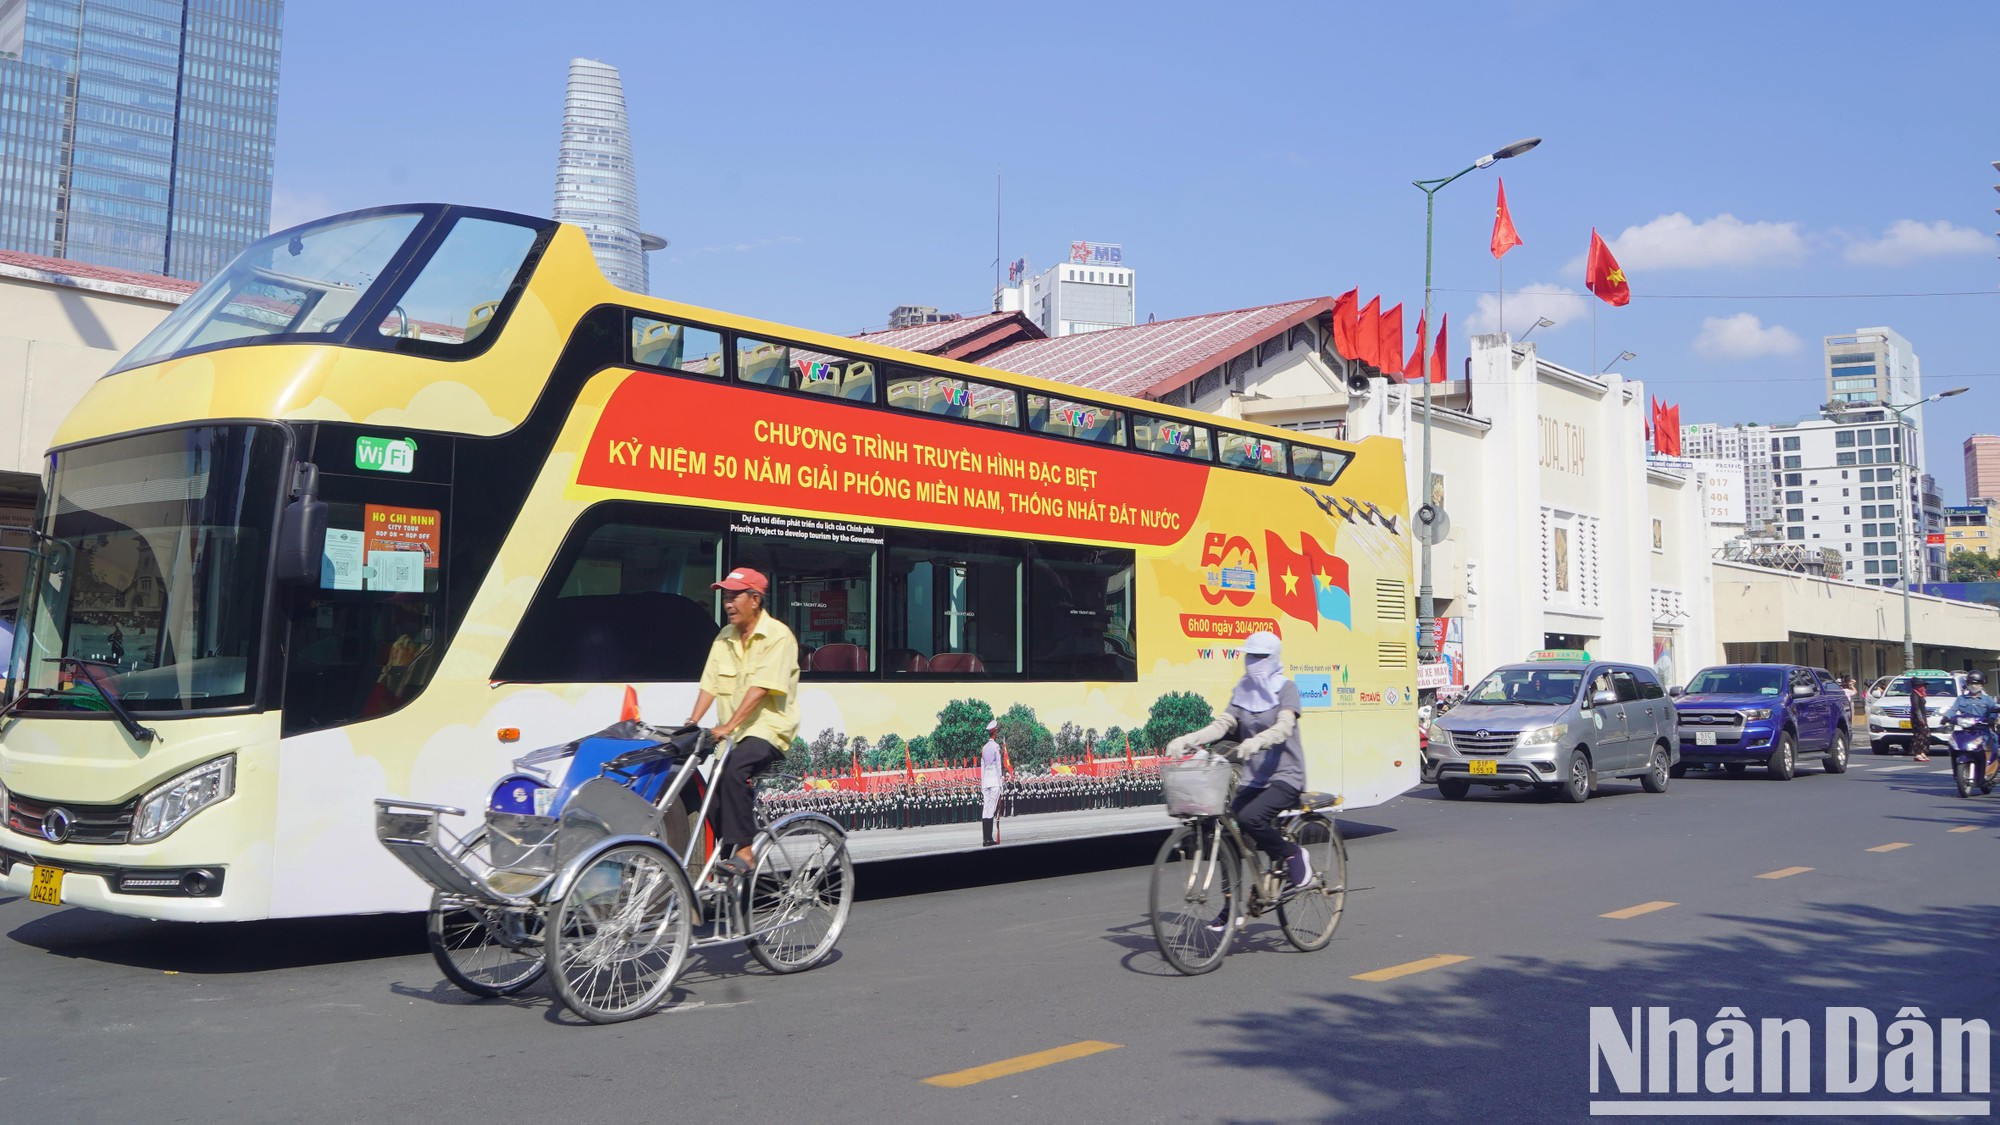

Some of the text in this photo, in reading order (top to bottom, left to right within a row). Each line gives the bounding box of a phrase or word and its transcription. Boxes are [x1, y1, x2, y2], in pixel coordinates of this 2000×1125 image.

[1094, 246, 1122, 262] MB
[797, 359, 830, 381] VTV
[1063, 409, 1094, 429] VTV9
[754, 420, 1097, 491] CHƯƠNG TRÌNH TRUYỀN HÌNH ĐẶC BIỆT
[609, 437, 1180, 530] KỶ NIỆM 50 NĂM GIẢI PHÓNG MIỀN NAM, THỐNG NHẤT ĐẤT NƯỚC
[372, 512, 435, 526] HO CHI MINH
[1711, 508, 1728, 516] 751
[404, 524, 419, 532] TOUR
[742, 514, 752, 524] Dự
[770, 516, 786, 525] điểm
[786, 518, 800, 528] phát
[816, 520, 824, 529] du
[825, 522, 834, 532] lịch
[846, 523, 862, 533] Chính
[730, 524, 884, 545] Priority Project to develop tourism by the Government
[1188, 618, 1274, 636] 6h00 ngày 30/4/2025
[1197, 649, 1214, 660] VTV1
[40, 868, 54, 884] 50F
